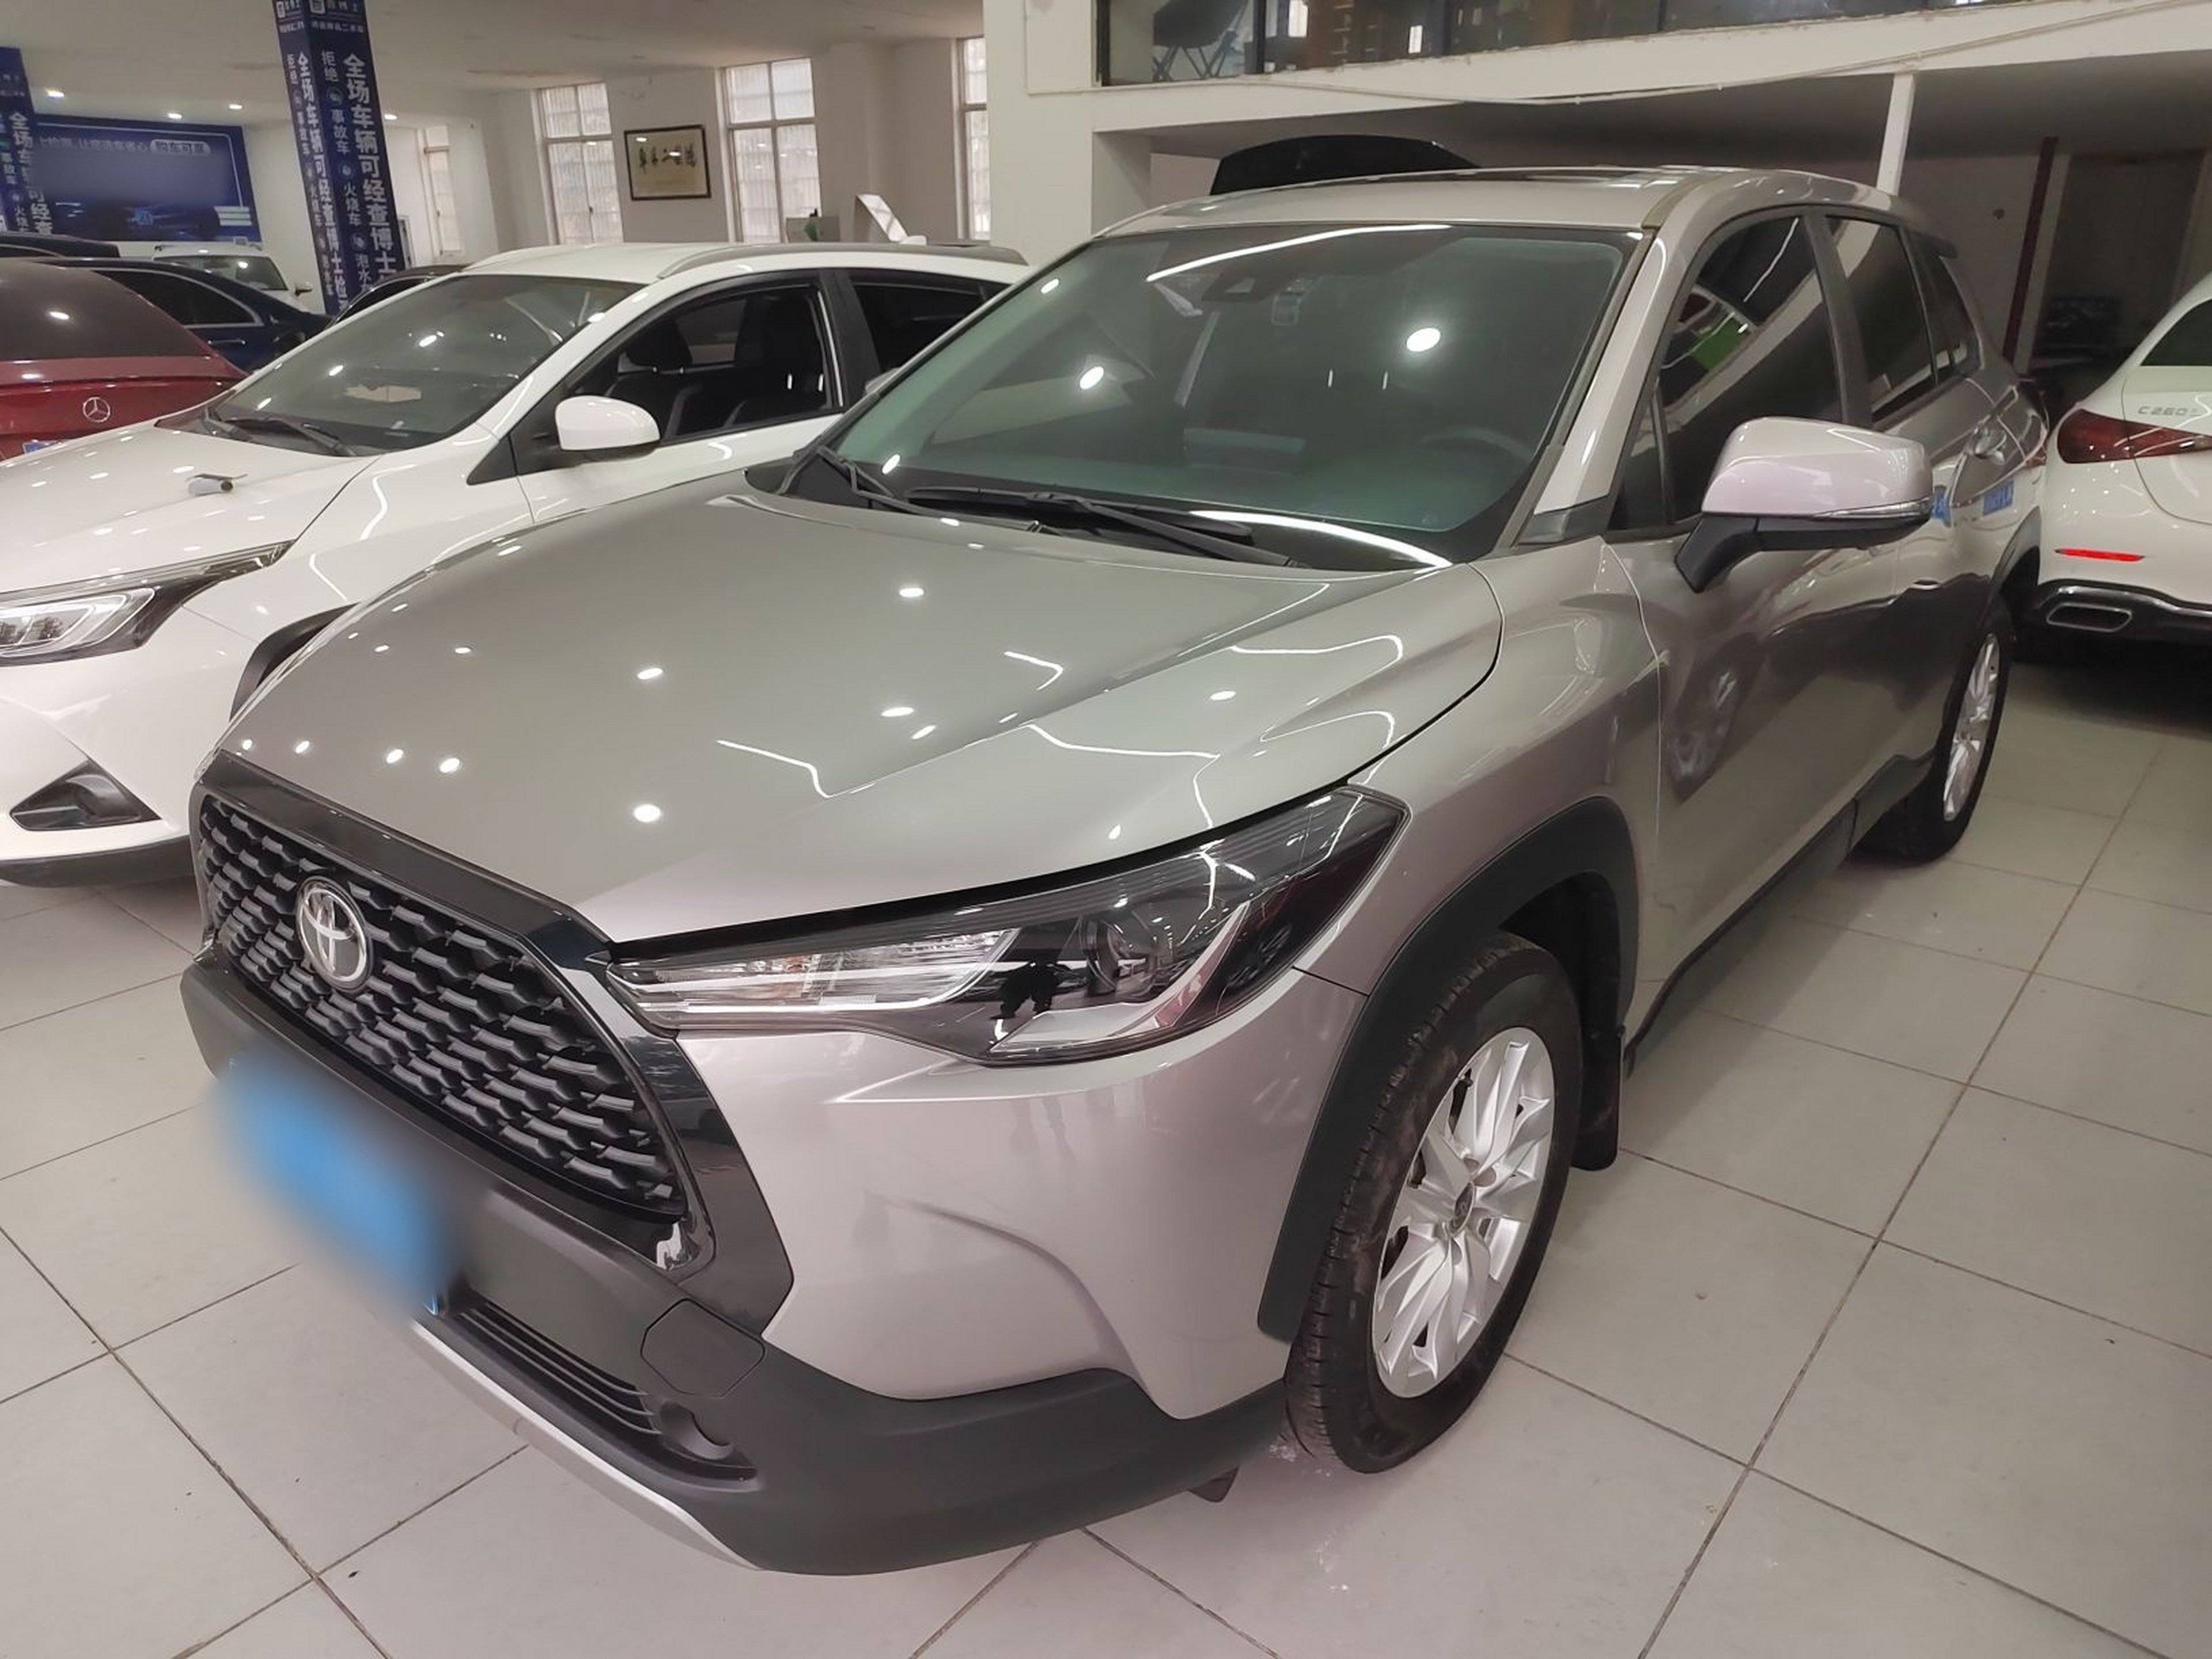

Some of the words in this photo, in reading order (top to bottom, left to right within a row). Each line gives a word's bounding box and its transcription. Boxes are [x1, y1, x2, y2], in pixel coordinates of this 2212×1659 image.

[321, 49, 339, 82] 拒绝
[343, 54, 397, 280] 全场车辆可经查博士
